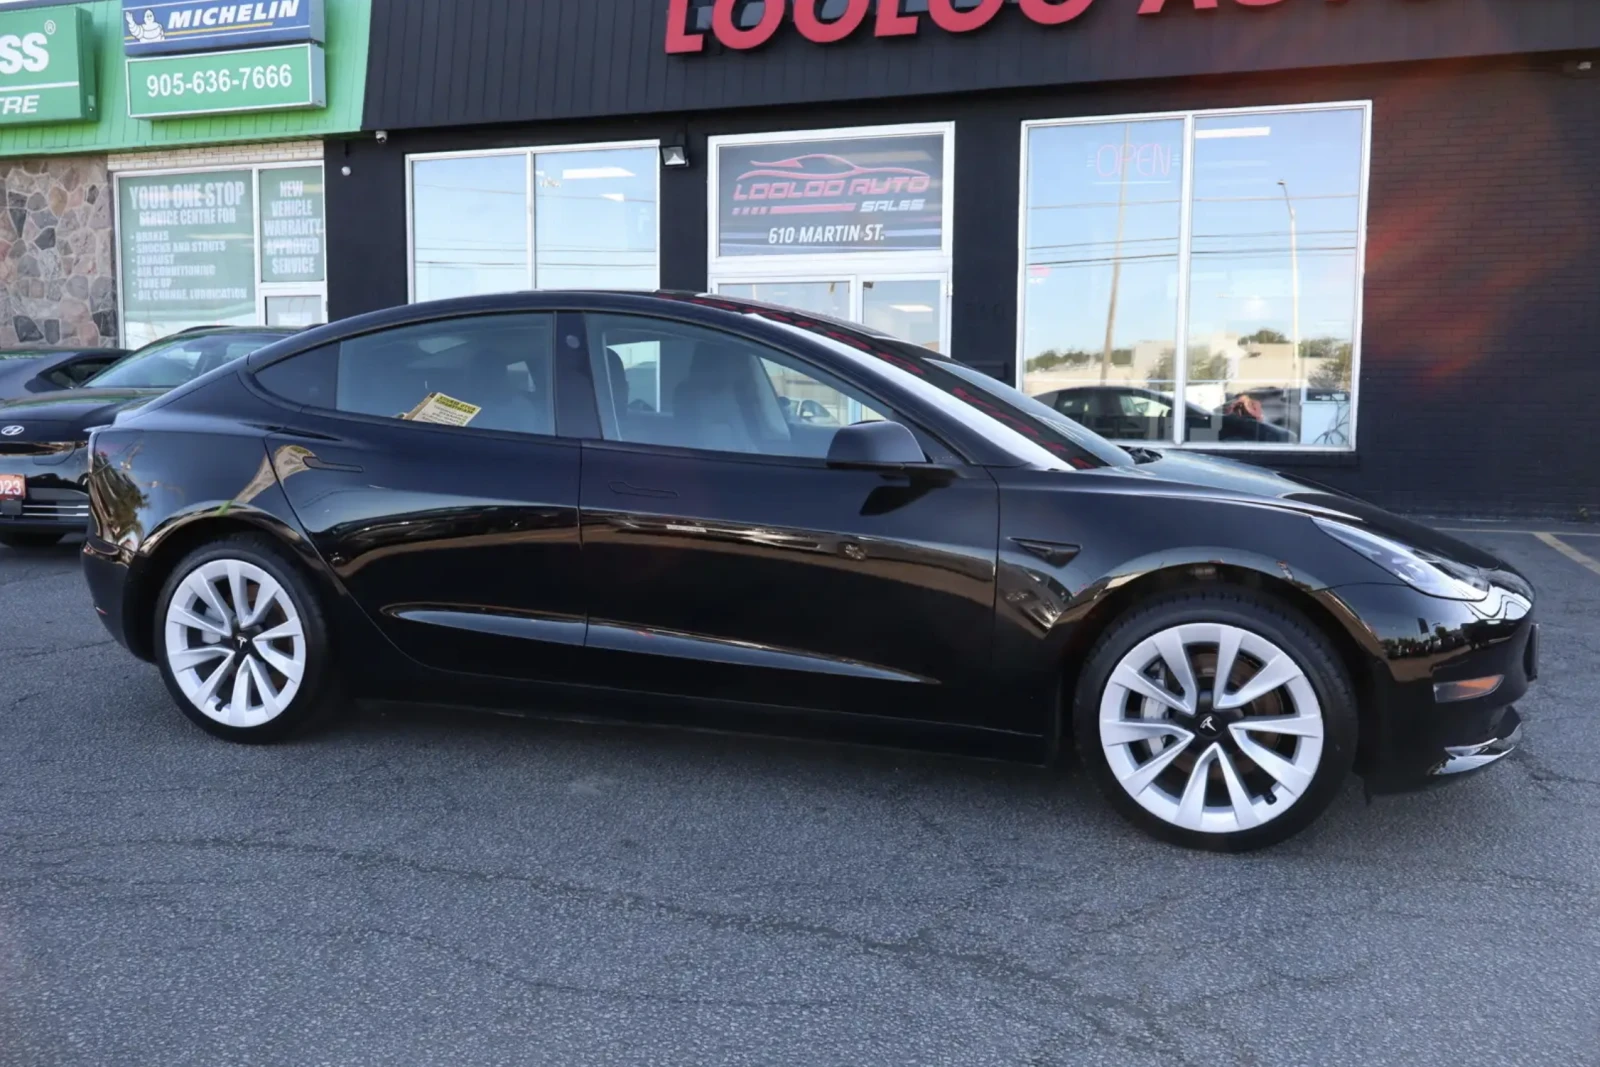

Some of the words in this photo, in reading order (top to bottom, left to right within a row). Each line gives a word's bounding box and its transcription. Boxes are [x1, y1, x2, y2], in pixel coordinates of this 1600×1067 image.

[167, 0, 300, 29] MICHELIN
[147, 64, 292, 97] 905-636-7666
[0, 95, 40, 114] RE
[1096, 143, 1171, 177] OPEN
[129, 185, 170, 210] YOUR
[173, 183, 202, 208] ONE
[205, 181, 245, 207] STOP
[280, 180, 303, 198] NEW
[733, 180, 846, 201] LOOLOO
[848, 176, 931, 196] AUTO
[271, 199, 313, 217] VEHICLE
[860, 199, 926, 212] SALES
[139, 210, 180, 227] SERVICE
[180, 208, 216, 225] CENTRE
[217, 207, 236, 224] FOR
[264, 218, 321, 236] WARRANTY
[768, 227, 796, 244] 610
[799, 225, 861, 243] MARTIN
[864, 224, 885, 241] ST.
[266, 237, 319, 256] APPROVED
[272, 257, 315, 275] SERVICE
